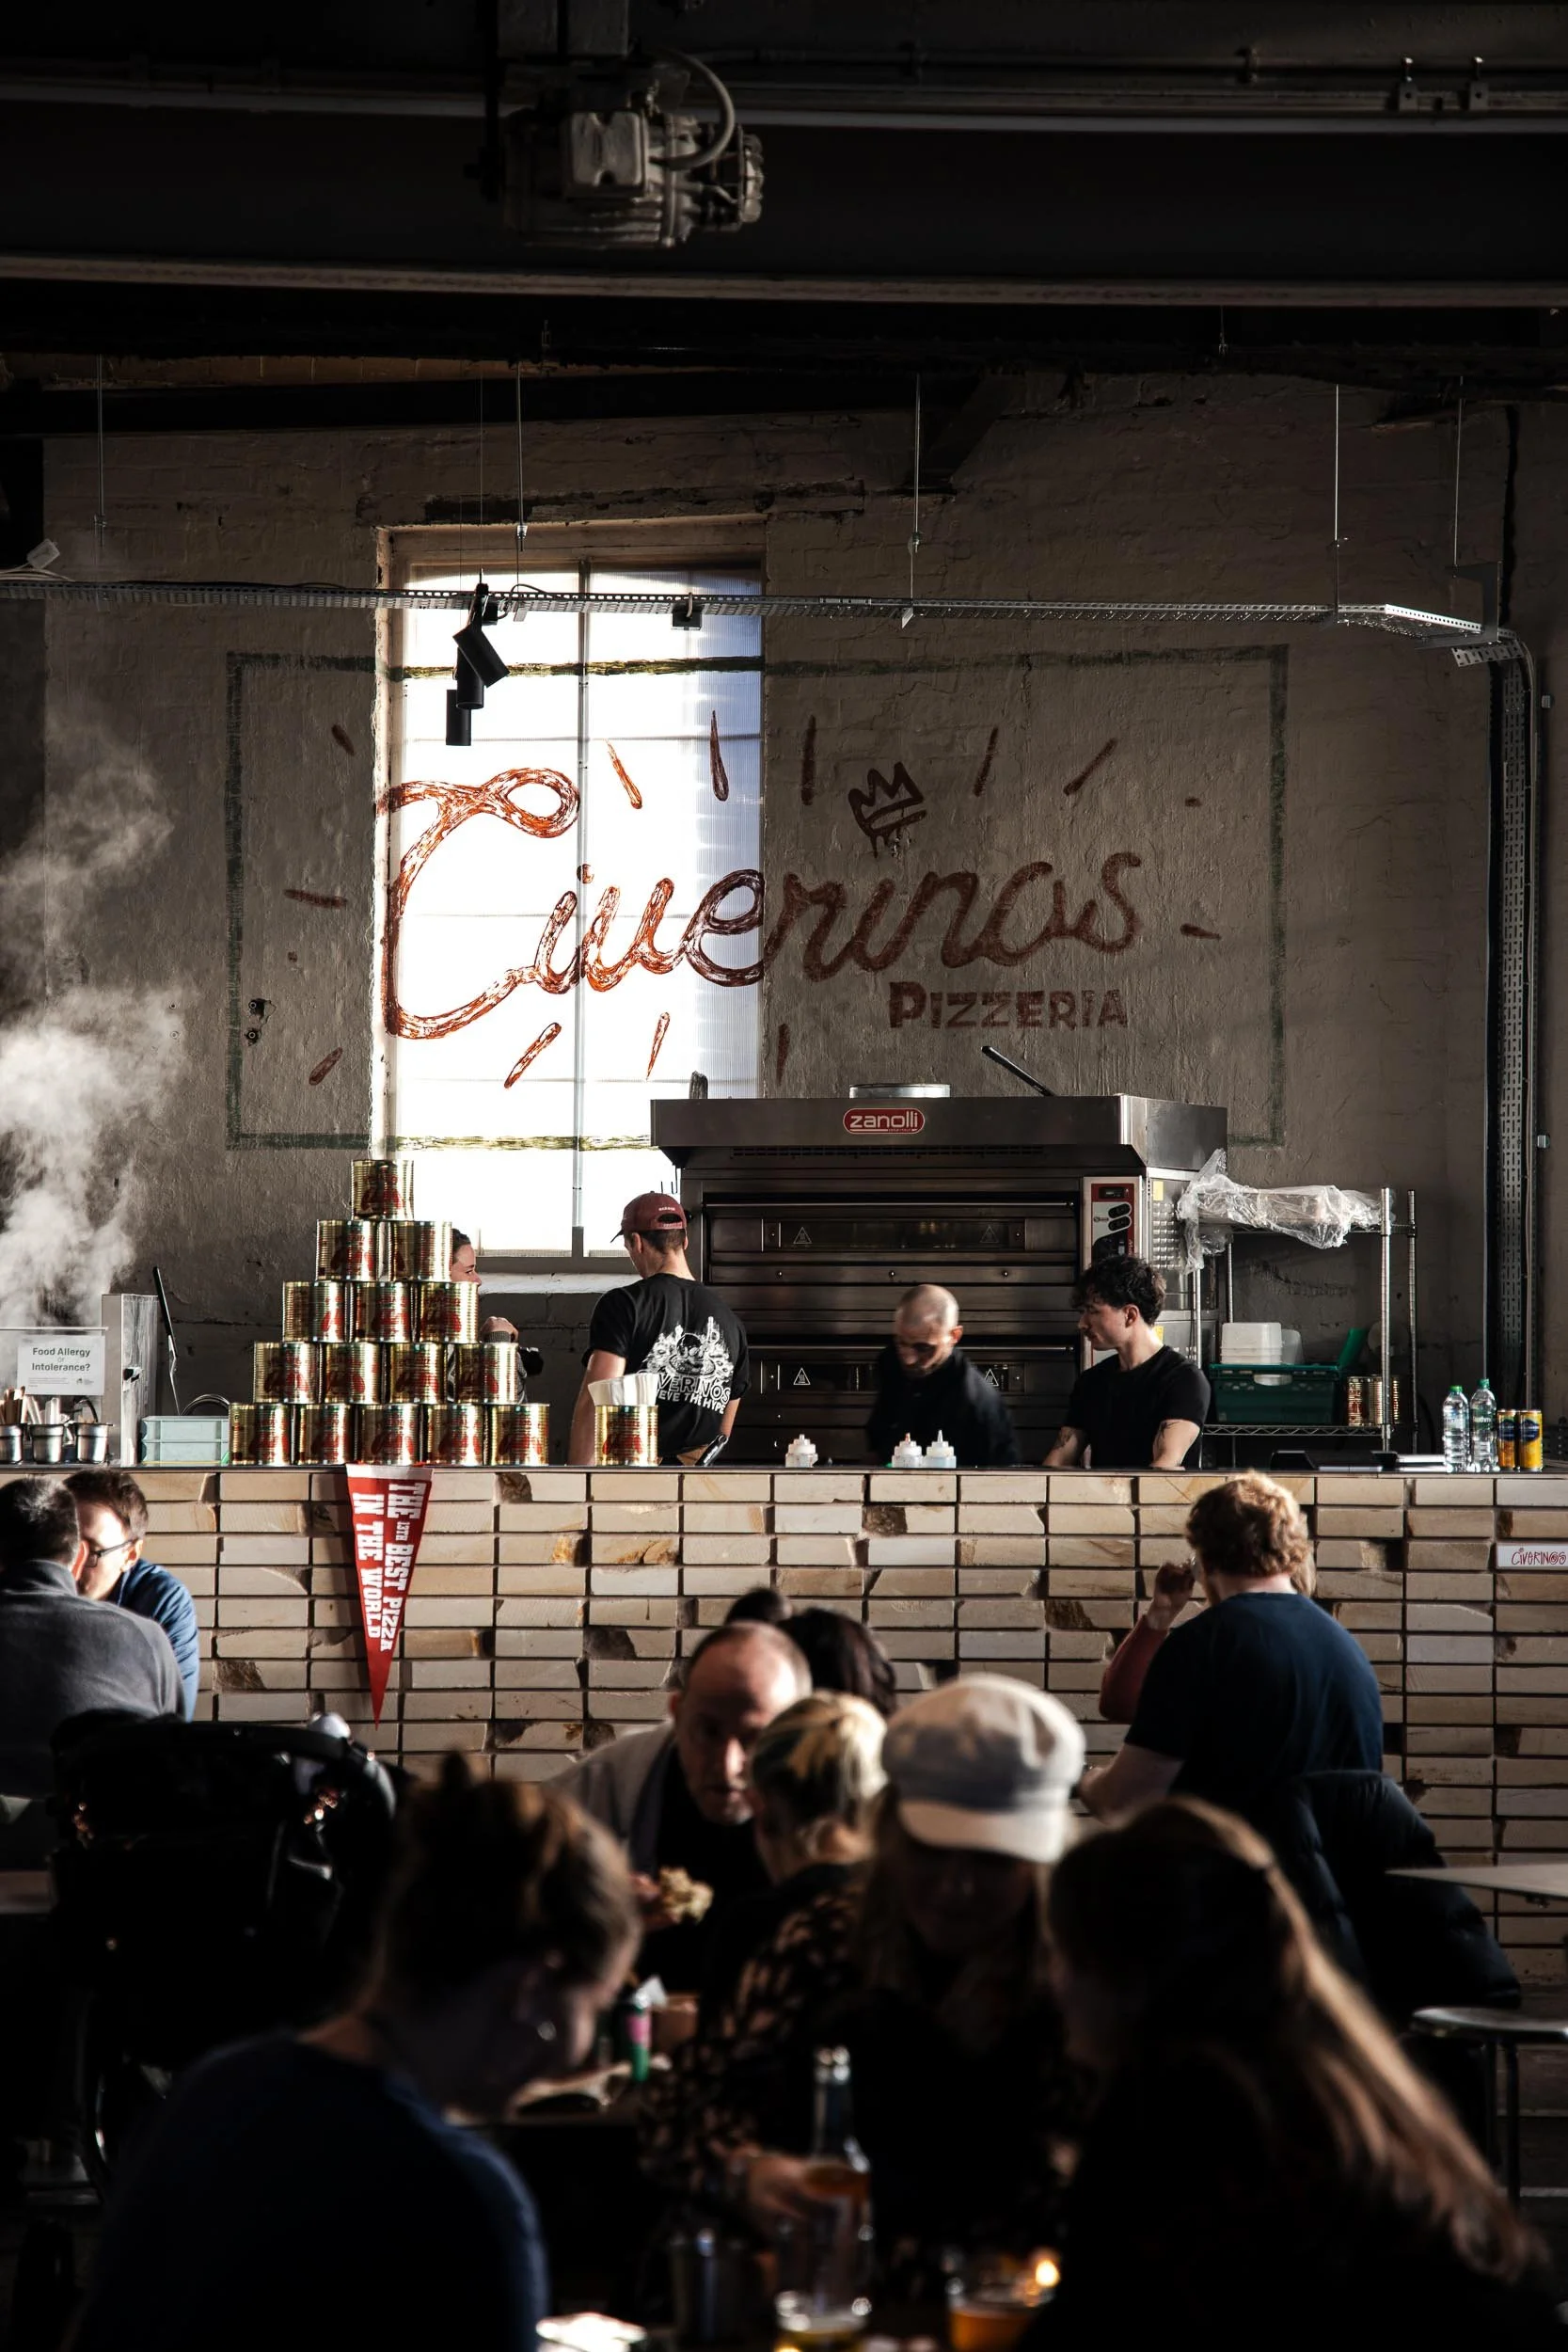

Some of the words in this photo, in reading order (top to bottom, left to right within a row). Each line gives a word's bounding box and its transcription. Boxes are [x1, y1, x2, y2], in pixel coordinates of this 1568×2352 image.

[889, 980, 1128, 1030] PIZZERIA
[849, 1110, 918, 1129] zanolli
[32, 1347, 55, 1356] Food
[57, 1347, 90, 1358] Allergy
[32, 1363, 91, 1372] Intolerance?
[657, 1373, 731, 1406] VERINOS
[684, 1392, 702, 1406] THE
[703, 1397, 727, 1415] HYPE
[352, 1492, 385, 1516] IN
[387, 1482, 427, 1519] THE
[356, 1520, 385, 1562] THE
[384, 1543, 415, 1592] BEST
[360, 1566, 384, 1639] WORLD
[379, 1597, 404, 1652] PIZZA
